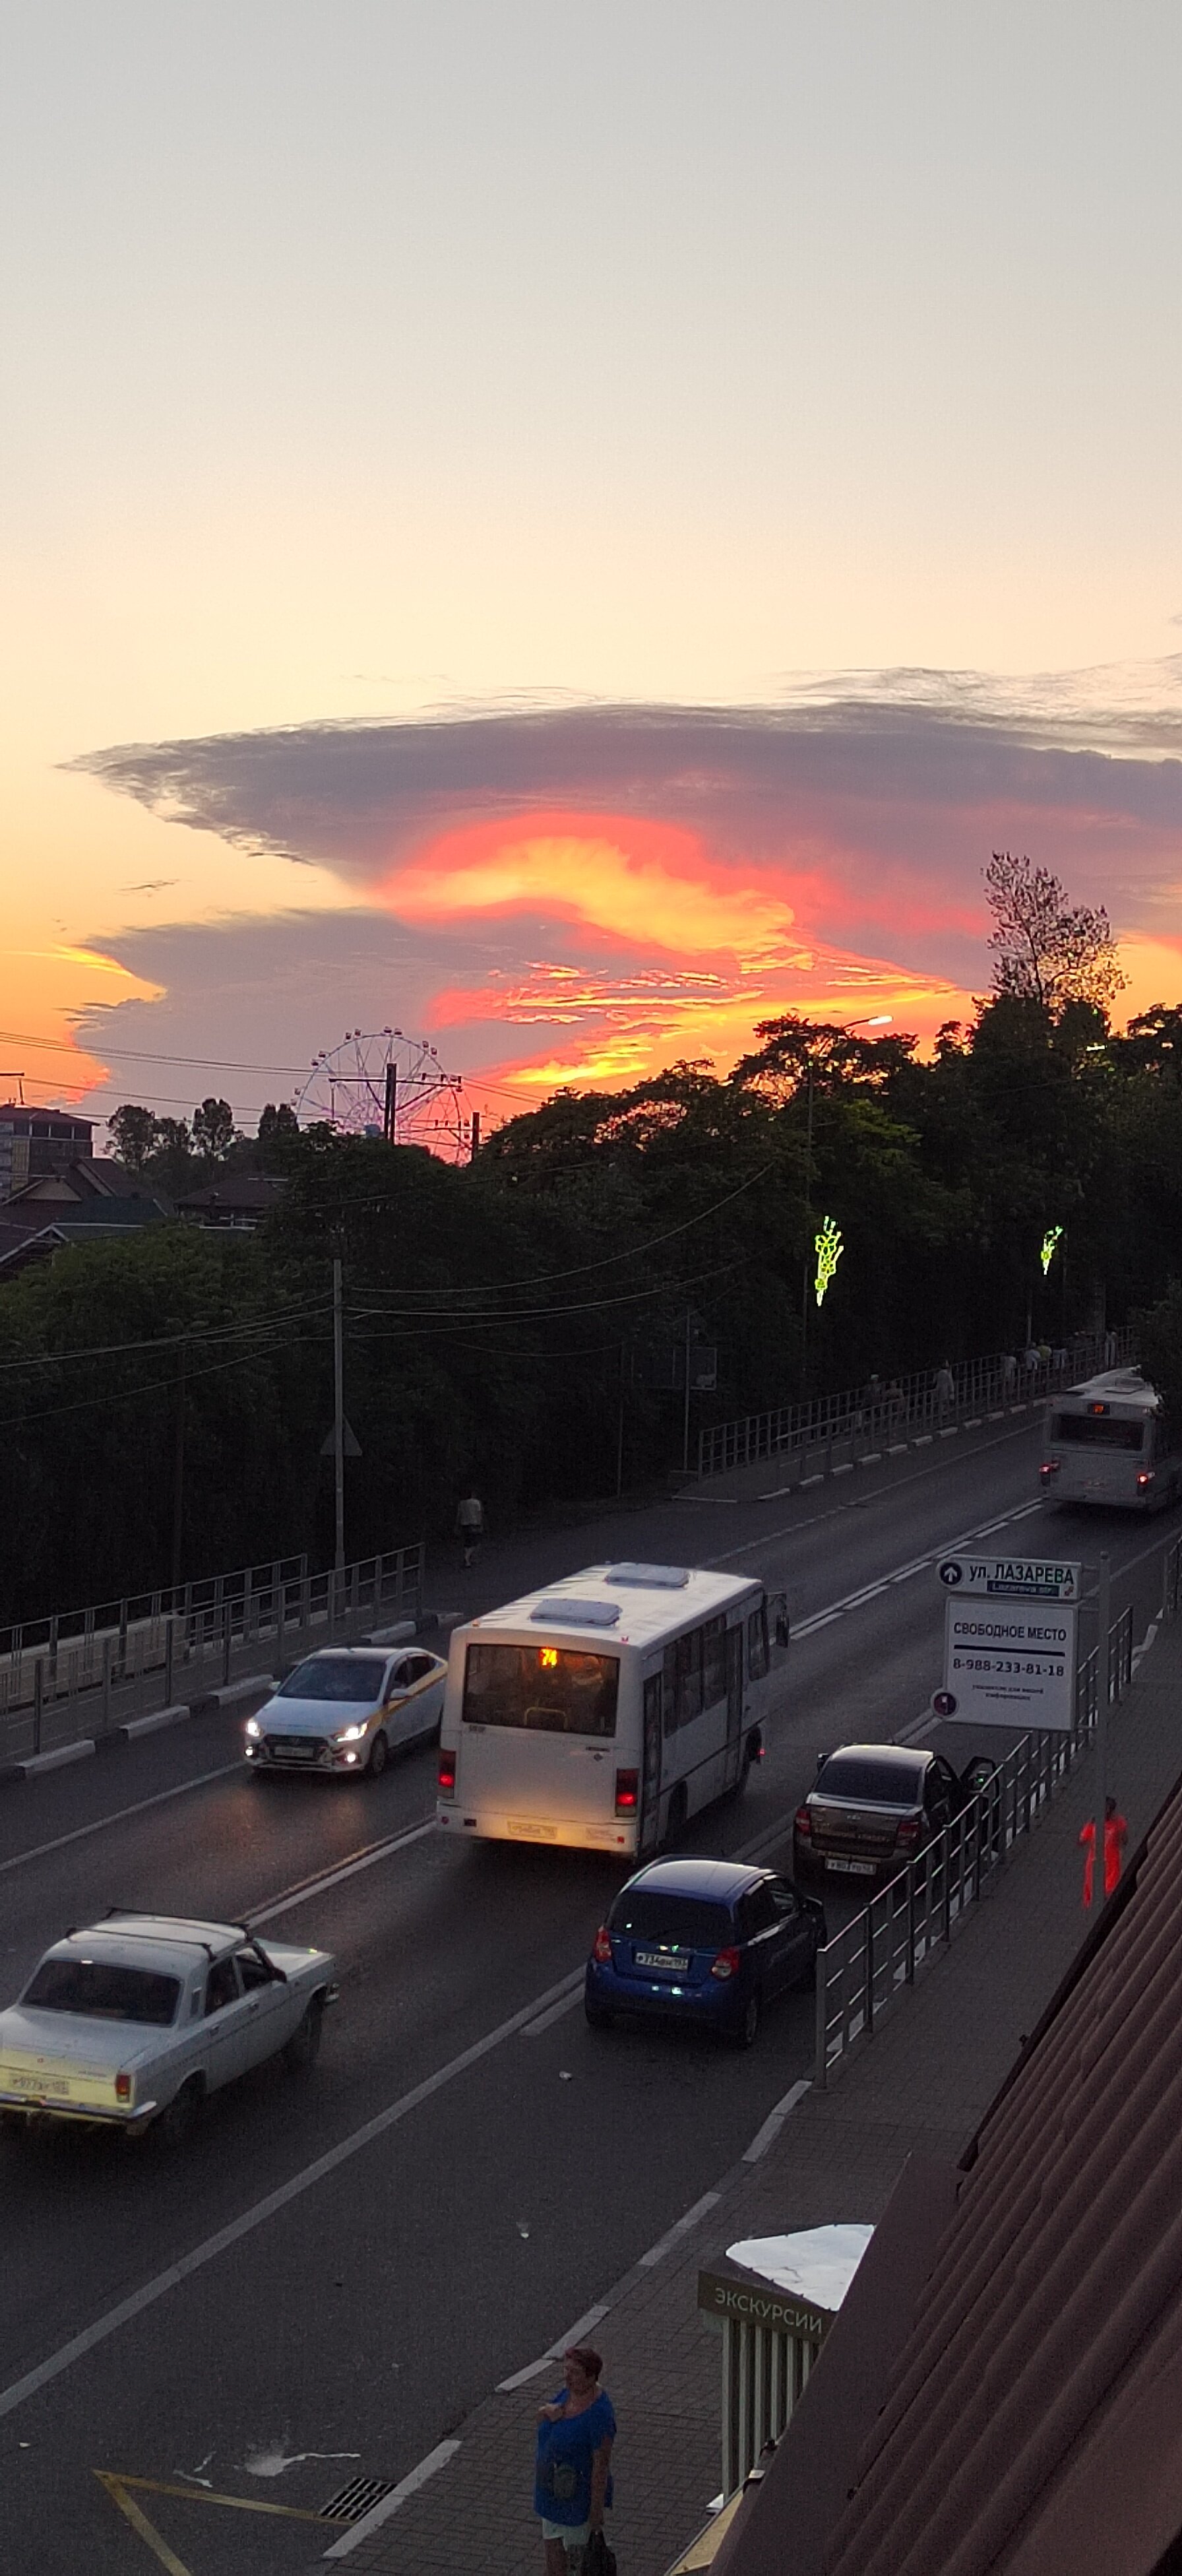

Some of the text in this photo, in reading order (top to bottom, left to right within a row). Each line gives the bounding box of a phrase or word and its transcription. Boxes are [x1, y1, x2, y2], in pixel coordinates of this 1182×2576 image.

[970, 1564, 1074, 1584] ул. ЛАЗАРЕВА
[954, 1622, 1067, 1641] СВОБОДНОЕ МЕСТО
[953, 1658, 1065, 1677] 8-988-233-81-18
[715, 2288, 823, 2334] ЭКСКУРСИИ
